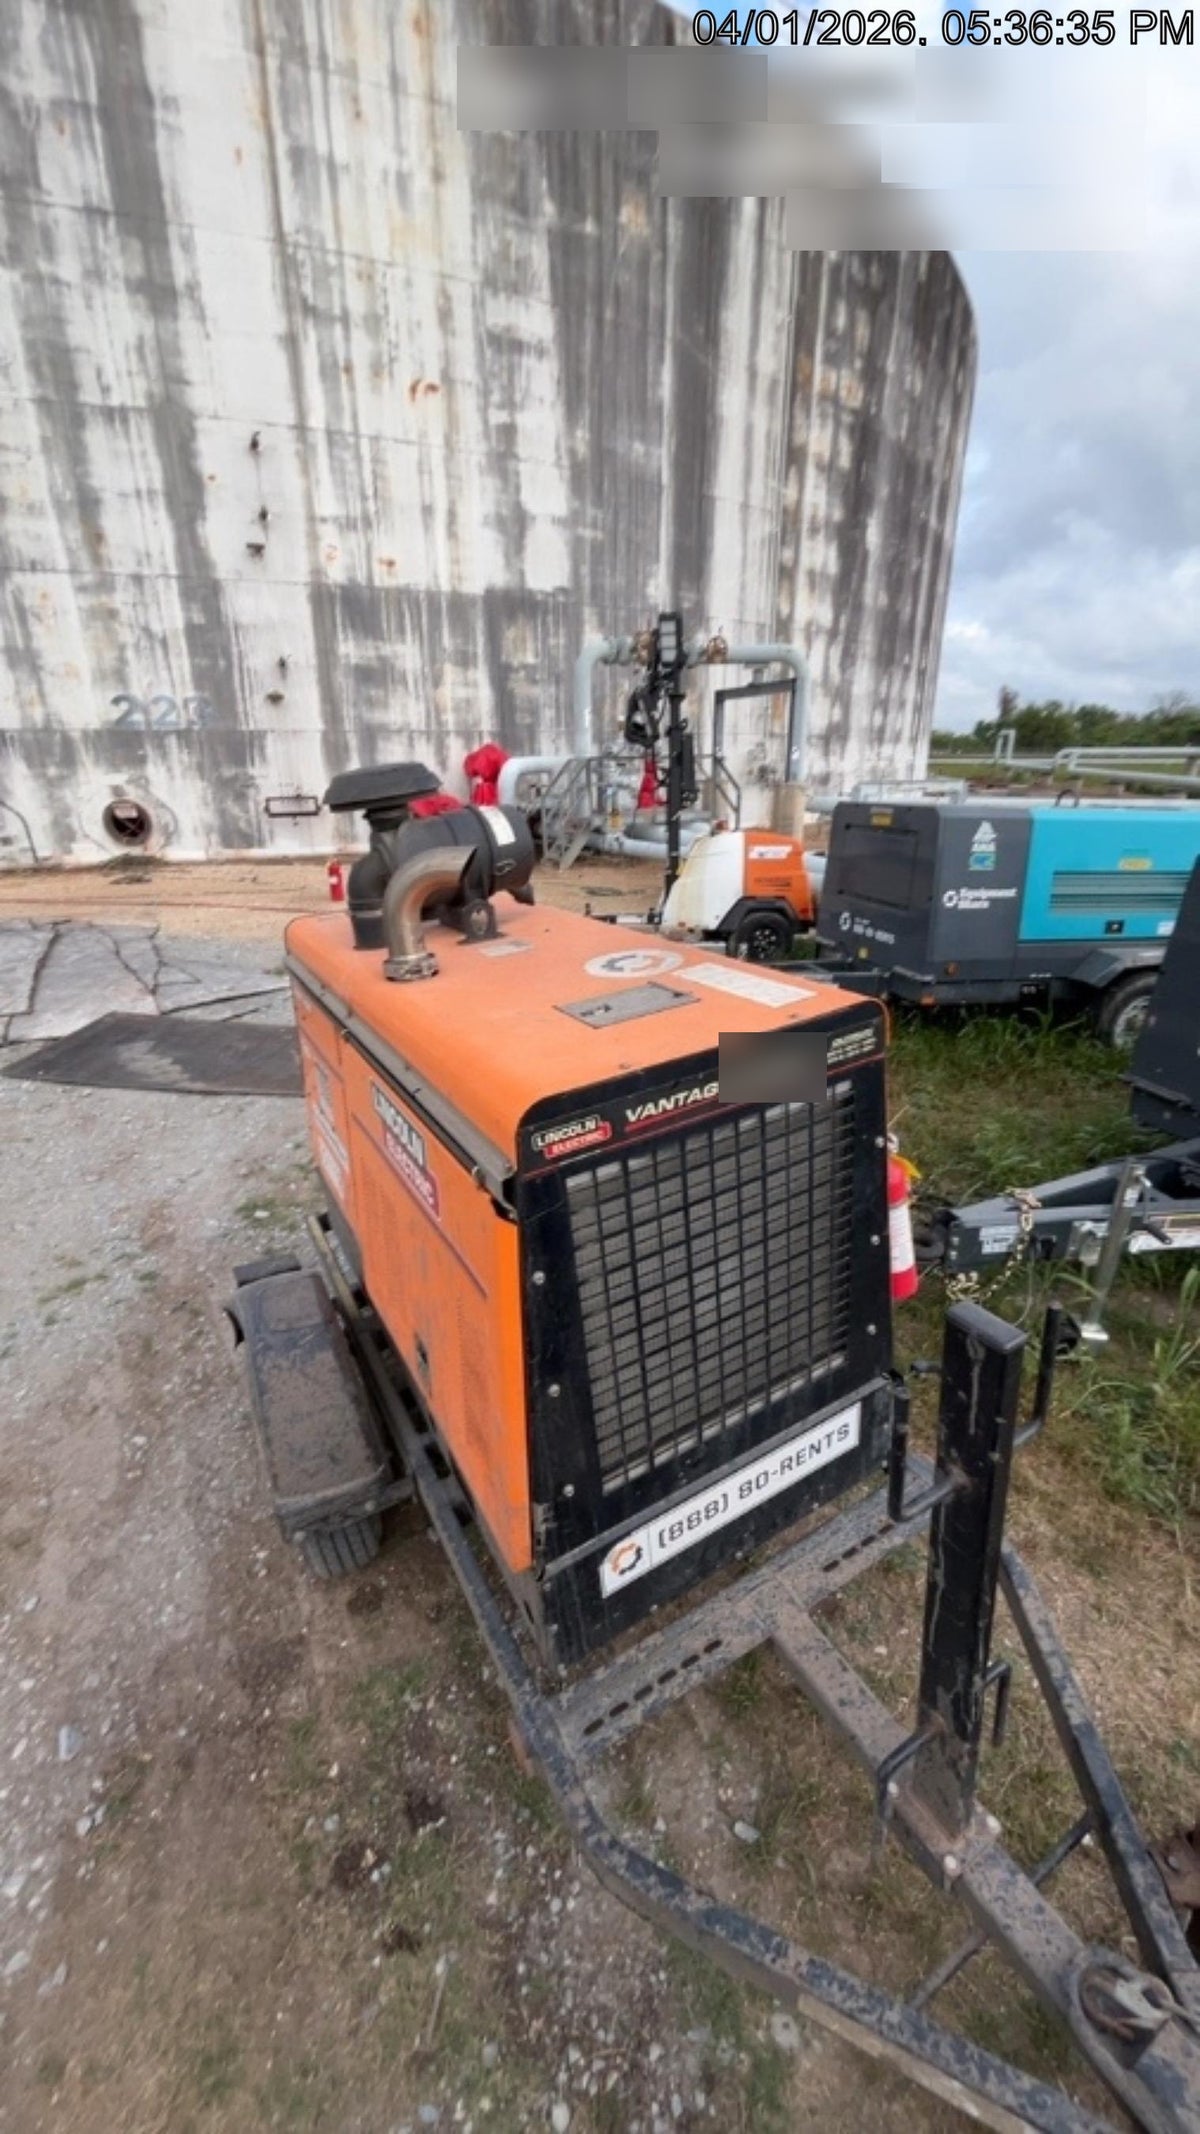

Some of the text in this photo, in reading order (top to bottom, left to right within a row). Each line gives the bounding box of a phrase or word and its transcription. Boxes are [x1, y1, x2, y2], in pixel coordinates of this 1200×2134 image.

[626, 1081, 719, 1122] VANTAG
[537, 1119, 597, 1147] LINCOLN
[658, 1423, 850, 1548] (888) 80-RENTS
